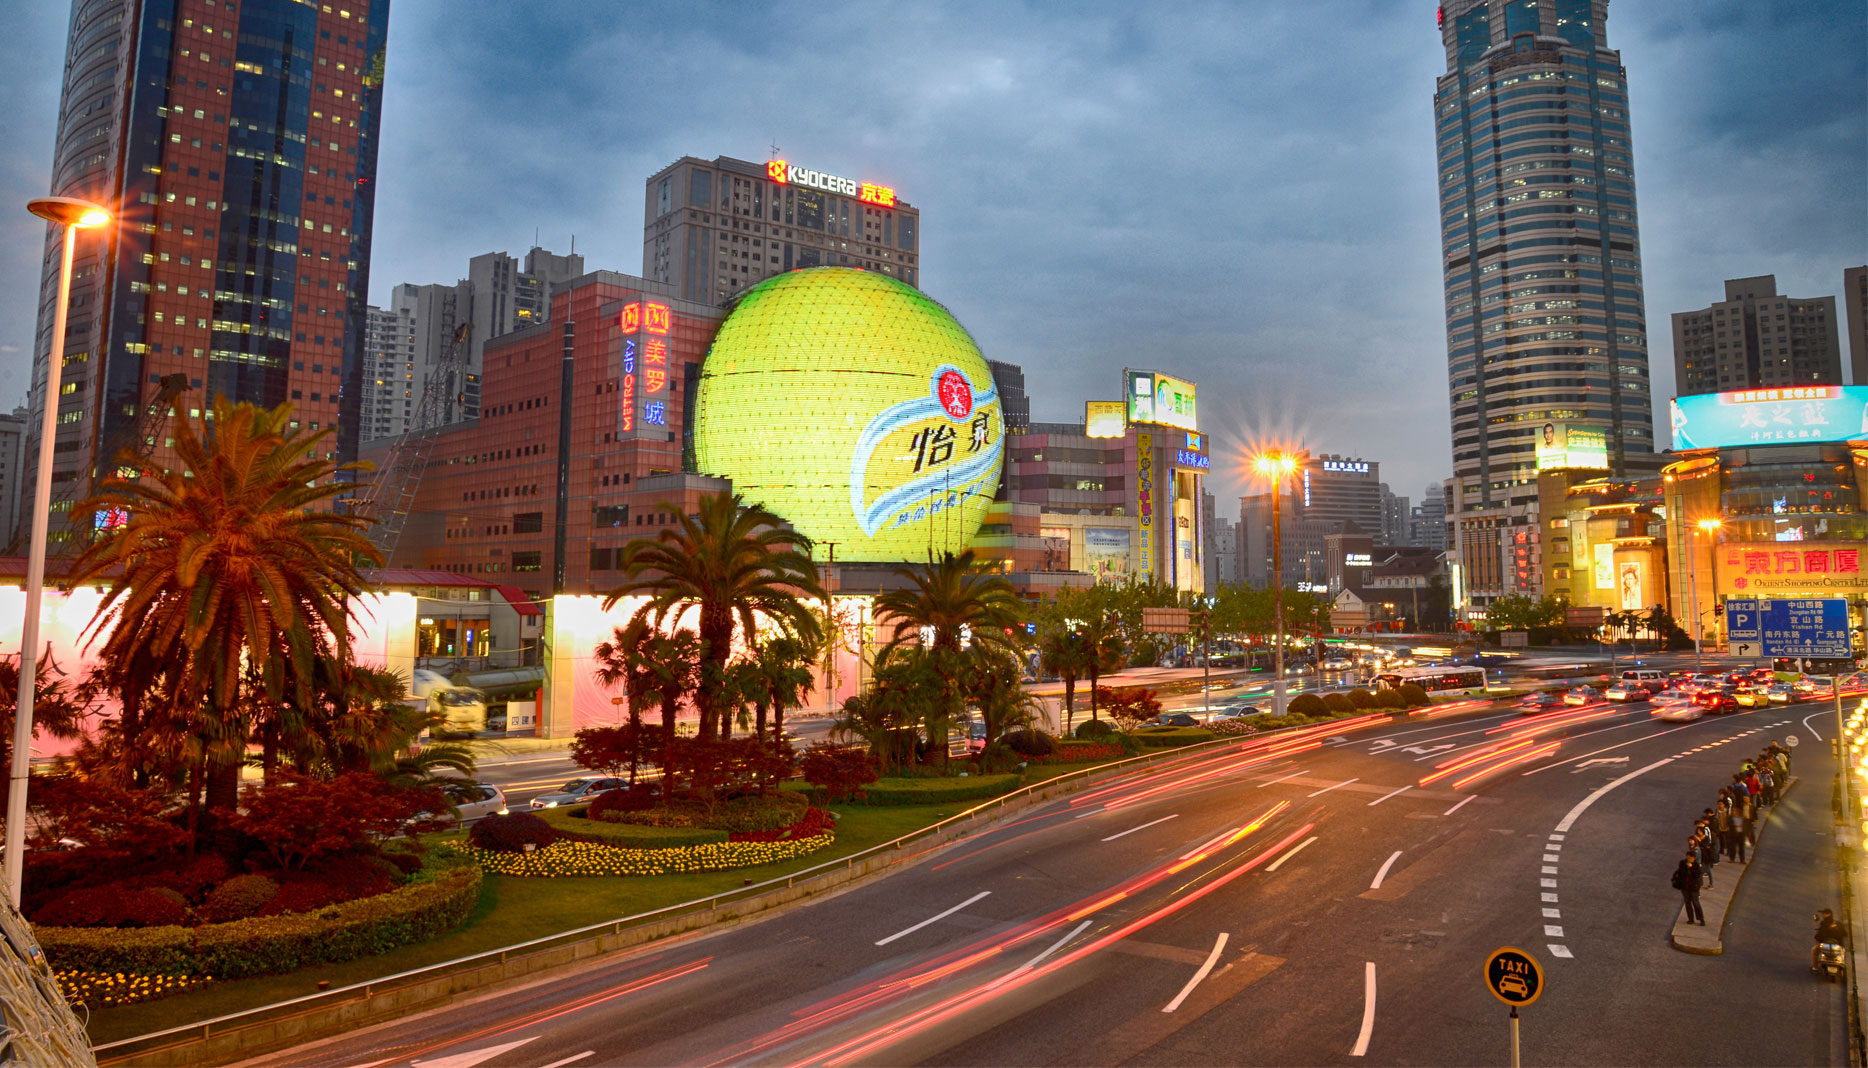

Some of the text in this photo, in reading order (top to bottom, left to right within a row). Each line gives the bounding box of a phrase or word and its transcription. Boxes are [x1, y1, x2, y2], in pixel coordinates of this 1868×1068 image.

[861, 182, 894, 206] 京瓷
[645, 339, 667, 425] 美罗城
[623, 374, 634, 431] METRO
[1788, 601, 1823, 609] 中山西路
[1737, 614, 1748, 627] P
[1790, 616, 1823, 624] 宜山路
[1499, 959, 1528, 975] TAXI
